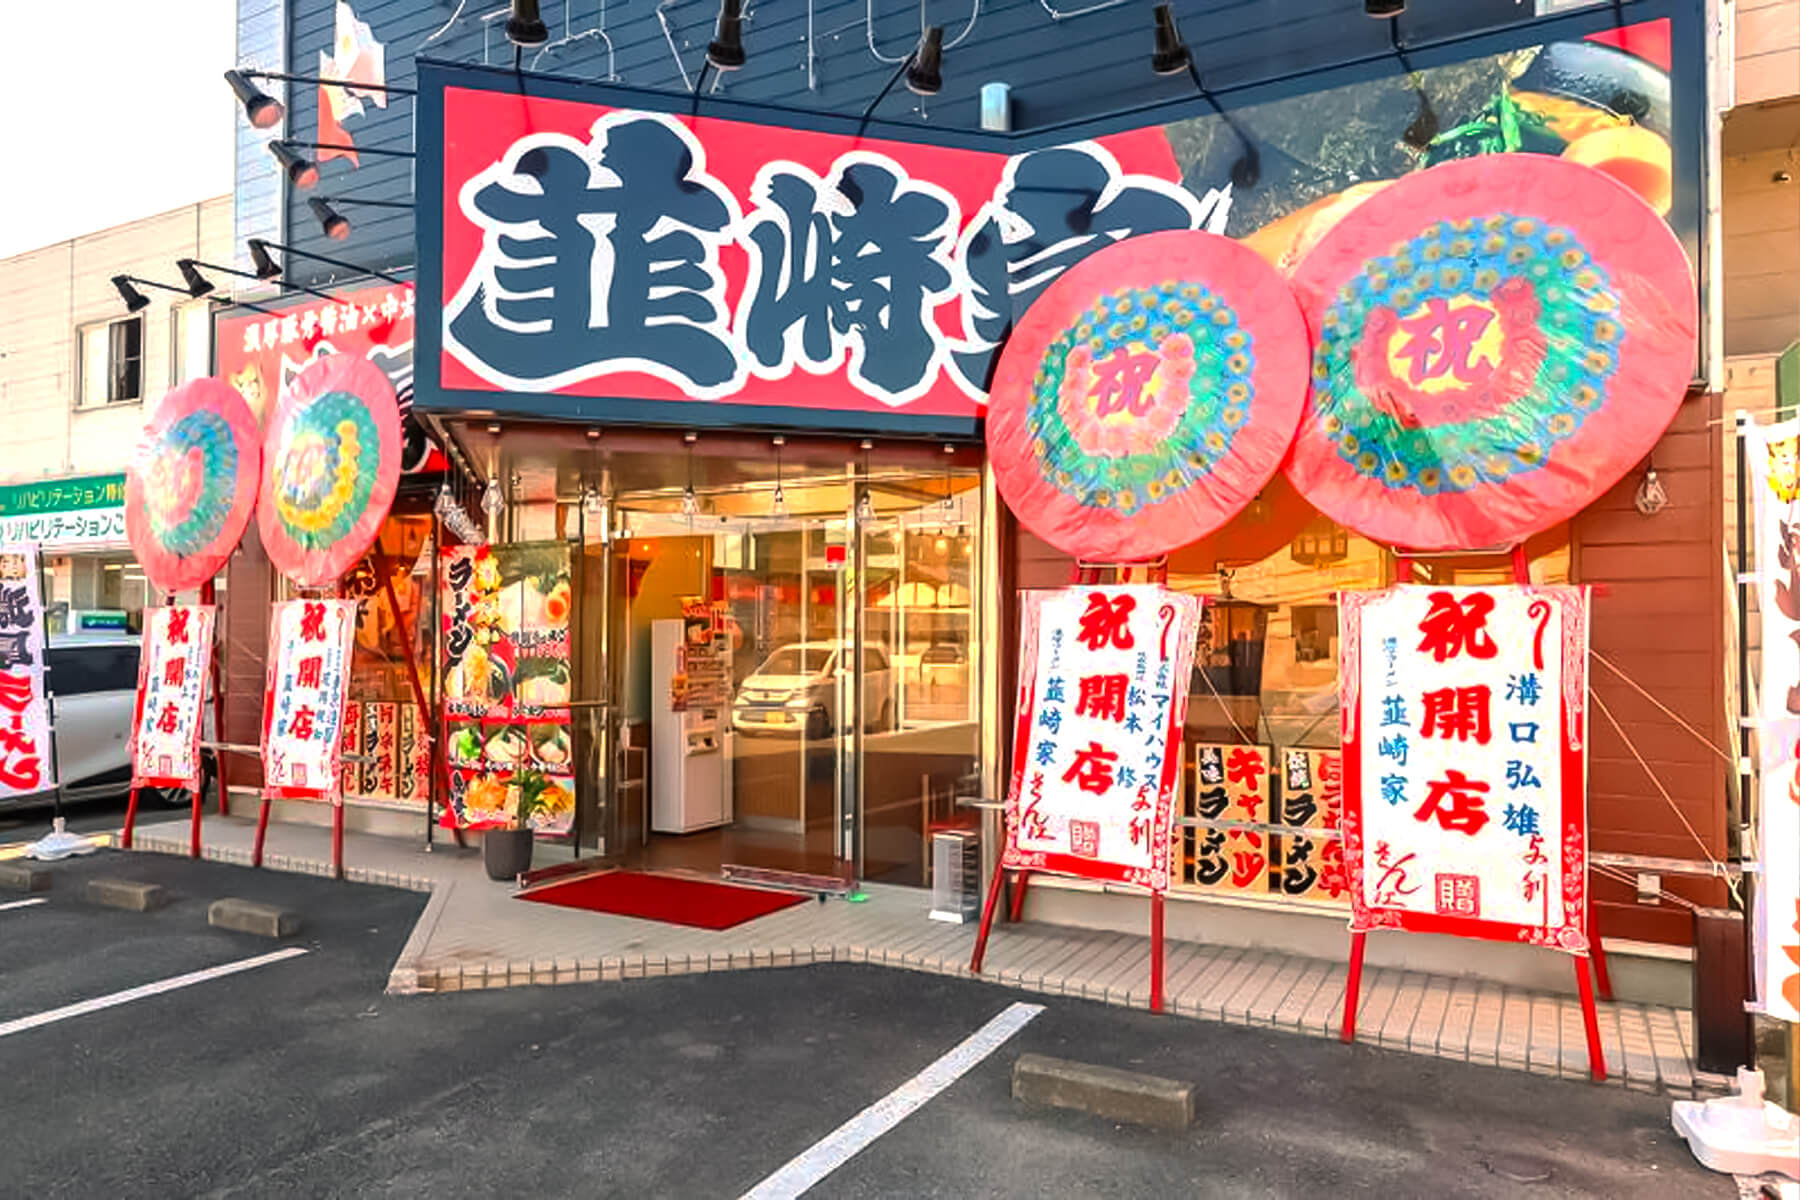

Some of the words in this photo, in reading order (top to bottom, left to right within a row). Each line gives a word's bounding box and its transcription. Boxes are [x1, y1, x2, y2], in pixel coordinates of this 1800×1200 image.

[1089, 348, 1161, 417] 祝
[1394, 297, 1496, 384] 祝
[448, 557, 472, 656] ラーメン
[157, 608, 190, 734] 祝開店
[288, 602, 327, 741] 祝開店
[1036, 676, 1066, 766] 韮崎家
[1062, 592, 1136, 796] 祝開店
[1413, 591, 1498, 836] 祝開店
[1378, 693, 1411, 806] 韮崎家
[1502, 672, 1544, 837] 溝口弘雄
